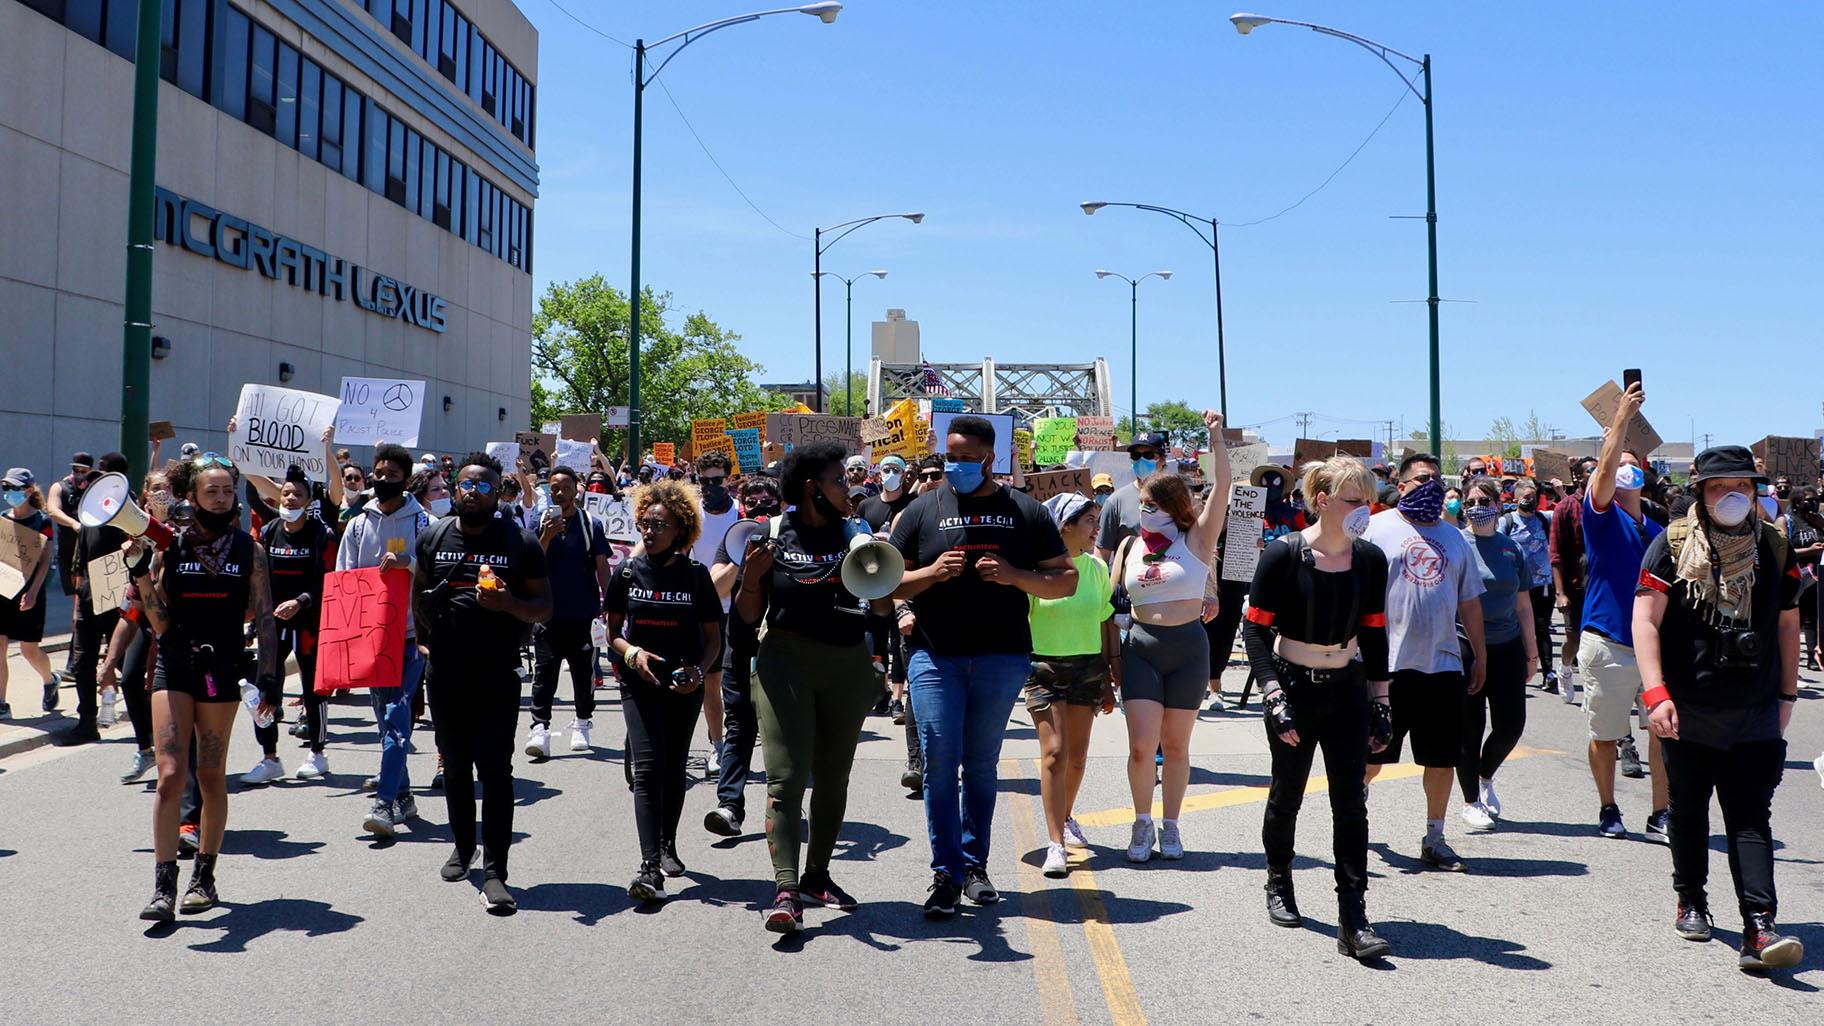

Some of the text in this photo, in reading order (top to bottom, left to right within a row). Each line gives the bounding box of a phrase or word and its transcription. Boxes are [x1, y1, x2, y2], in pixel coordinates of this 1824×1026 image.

[351, 265, 448, 333] LEXUS
[344, 382, 369, 405] NO
[276, 394, 322, 425] GOT
[370, 408, 378, 418] 4
[798, 417, 838, 434] PIGS
[1077, 417, 1090, 427] NO
[1077, 427, 1090, 435] NO
[248, 417, 305, 450] BLOOD
[233, 445, 249, 463] ON
[256, 449, 286, 469] YOUR
[1769, 438, 1818, 461] BLACK
[1024, 472, 1083, 492] BLACK
[1234, 486, 1259, 499] END
[586, 496, 630, 517] FUCK
[1233, 498, 1254, 510] THE
[1231, 509, 1266, 520] VIOLENCE
[319, 590, 398, 632] IVES
